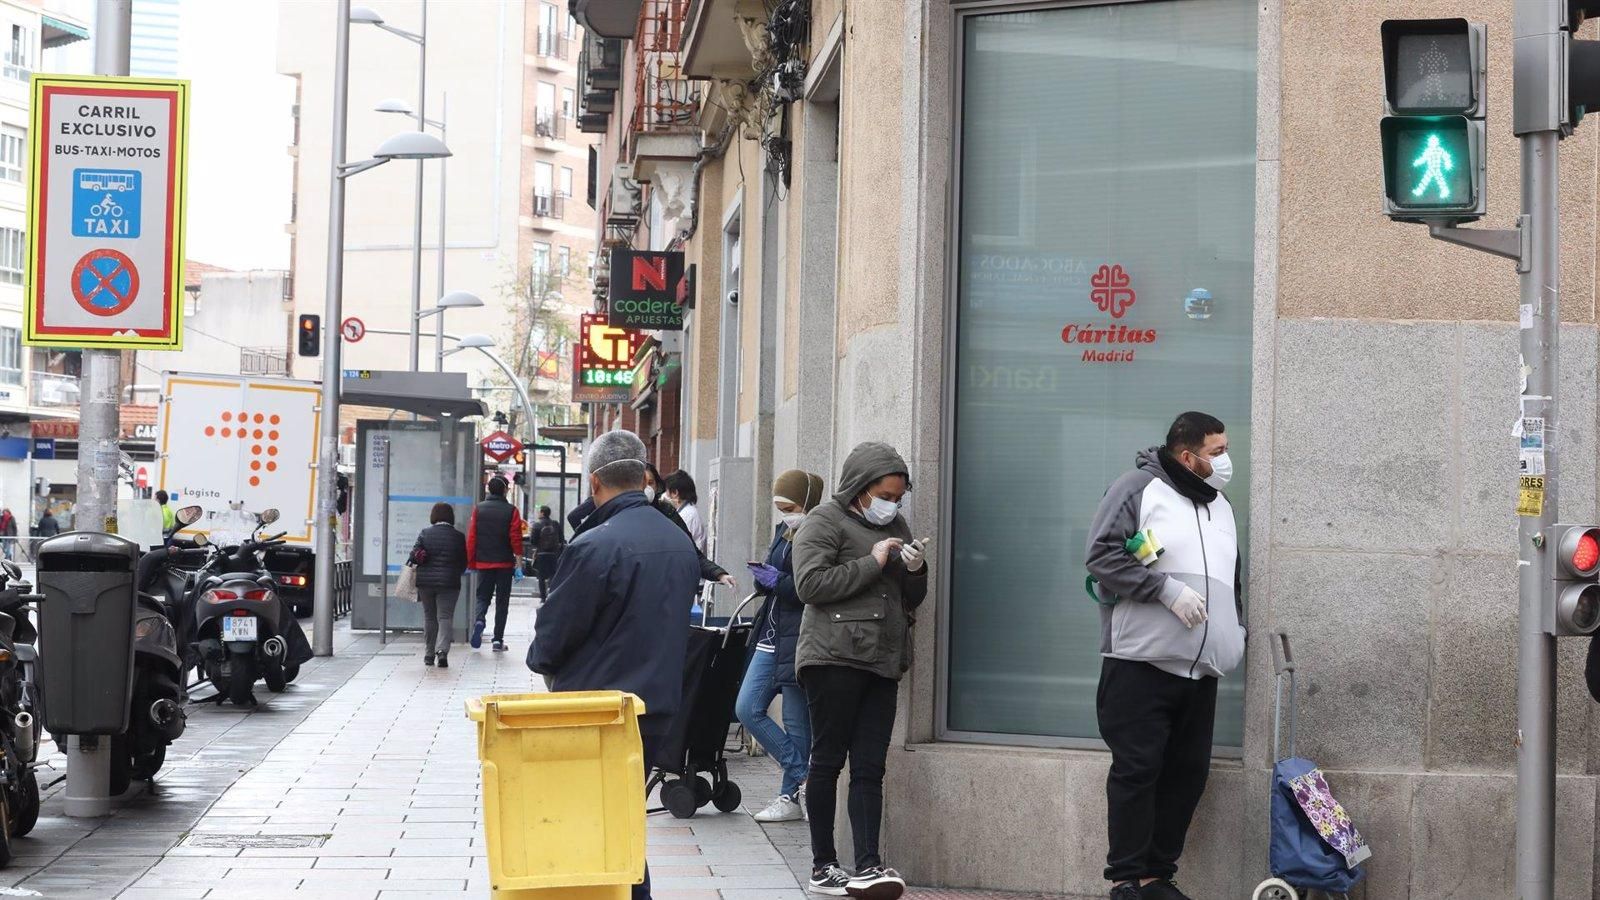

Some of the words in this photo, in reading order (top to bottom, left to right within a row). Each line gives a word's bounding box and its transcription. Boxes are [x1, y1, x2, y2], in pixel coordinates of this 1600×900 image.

[78, 105, 140, 120] CARRIL
[61, 122, 156, 138] EXCLUSIVO
[55, 144, 161, 159] BUS-TAXI-MOTOS
[84, 218, 129, 235] TAXI
[614, 298, 682, 315] codere
[626, 315, 682, 325] APUESTAS
[1061, 324, 1156, 344] Cáritas
[1081, 349, 1135, 362] Madrid
[36, 442, 52, 450] BBVA
[489, 441, 511, 450] Metro
[184, 487, 220, 498] Logista
[232, 619, 253, 628] 8741
